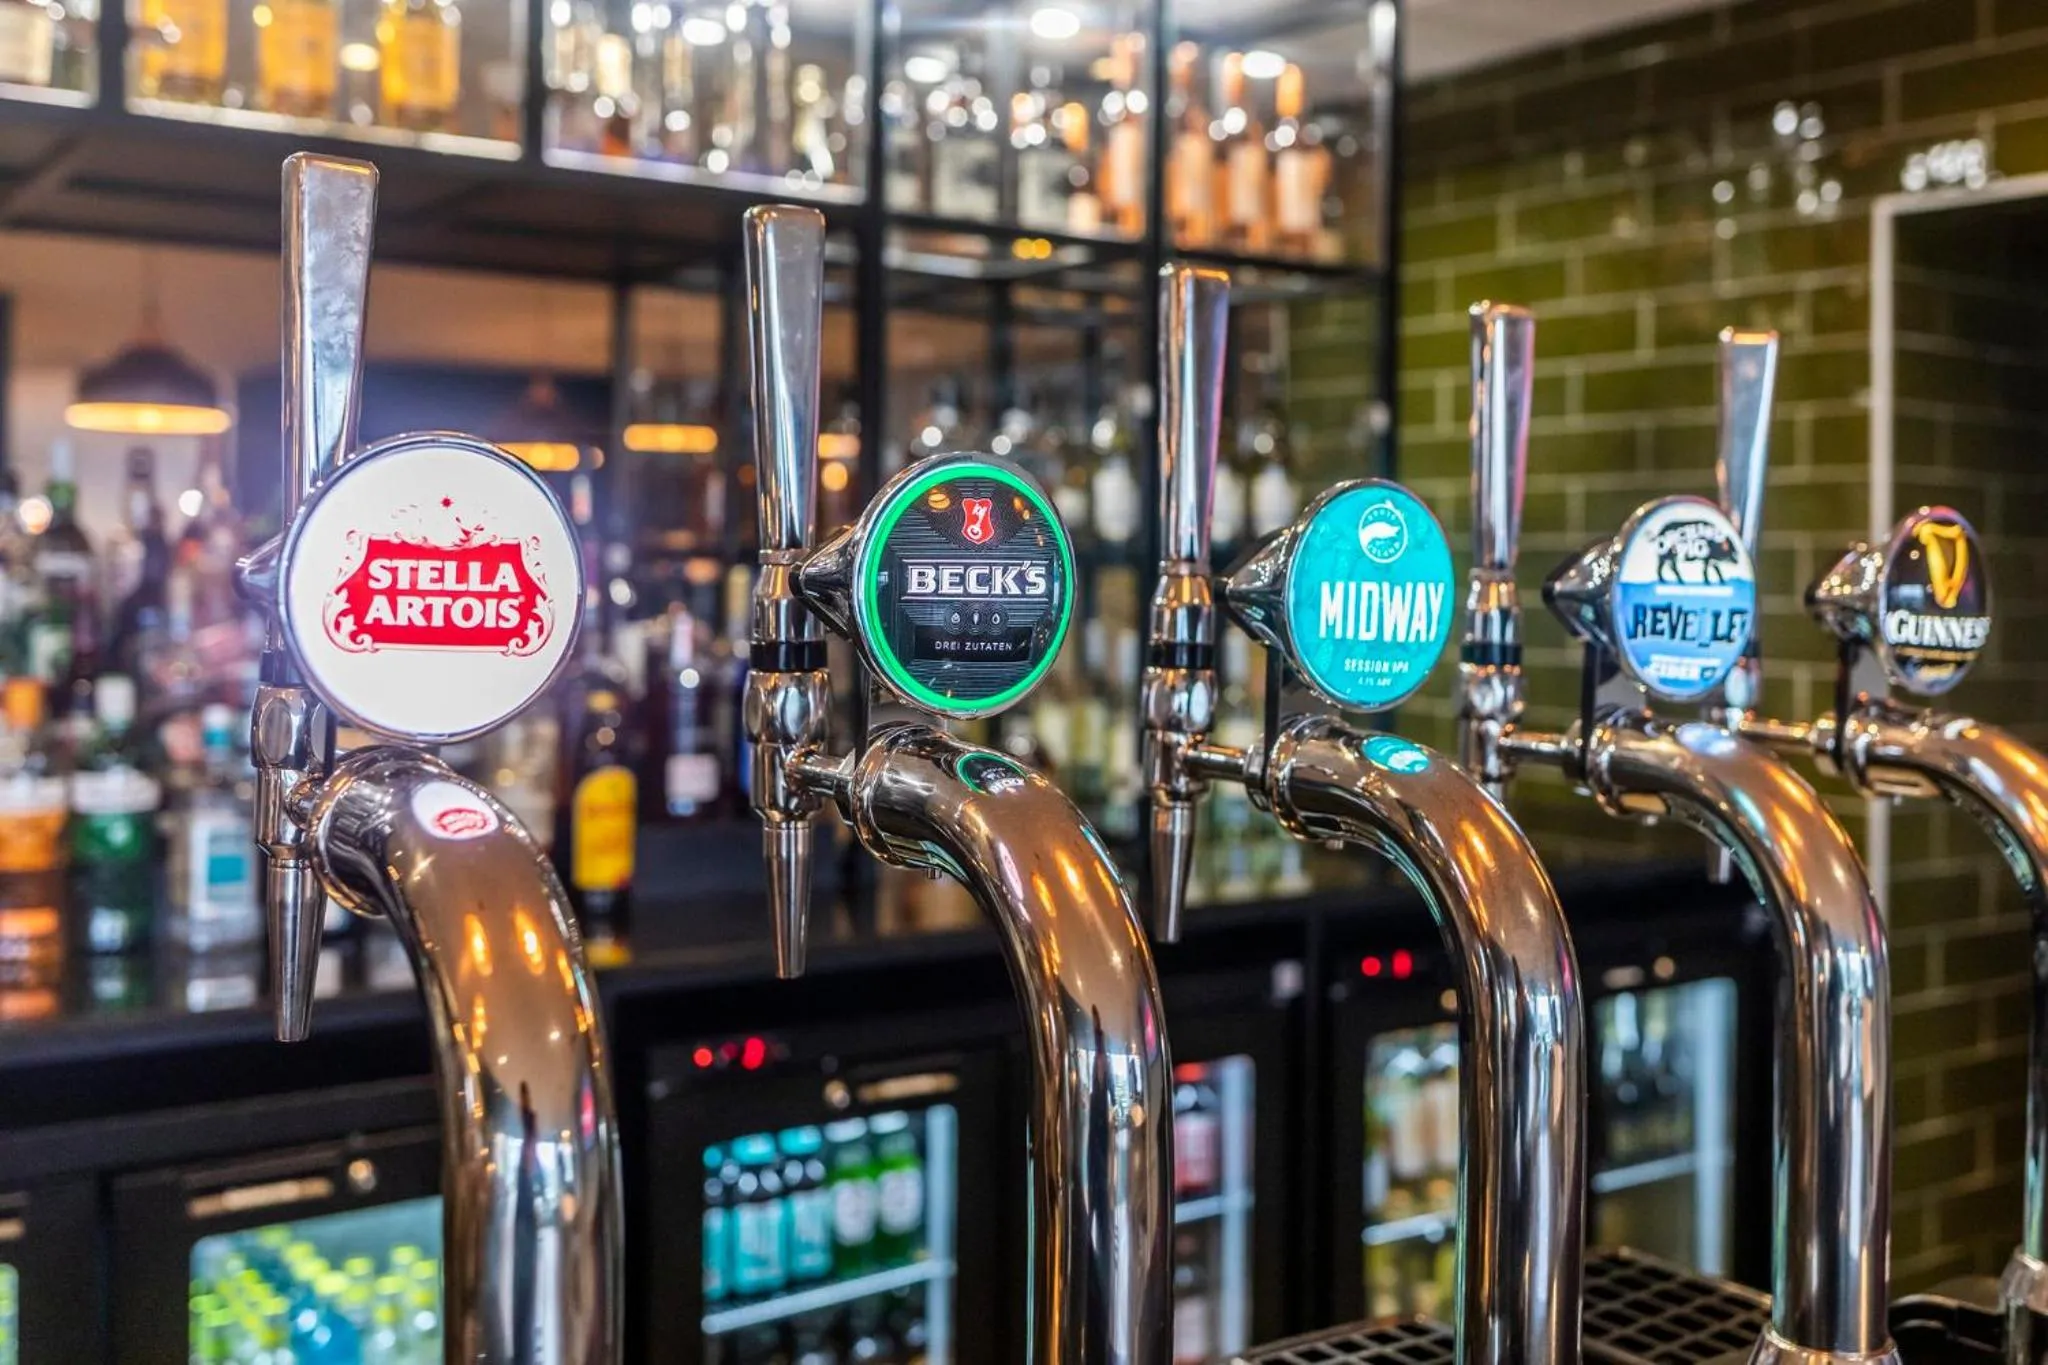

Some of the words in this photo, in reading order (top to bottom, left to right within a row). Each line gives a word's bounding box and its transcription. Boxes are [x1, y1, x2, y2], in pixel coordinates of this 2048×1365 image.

[367, 558, 521, 593] STELLA
[907, 561, 1047, 596] BECK'S
[363, 595, 521, 629] ARTOIS
[1318, 580, 1444, 644] MIDWAY
[934, 640, 961, 651] DREI
[964, 641, 1013, 651] ZUTATEN
[1344, 658, 1389, 674] SESSION
[1392, 660, 1409, 674] IPA
